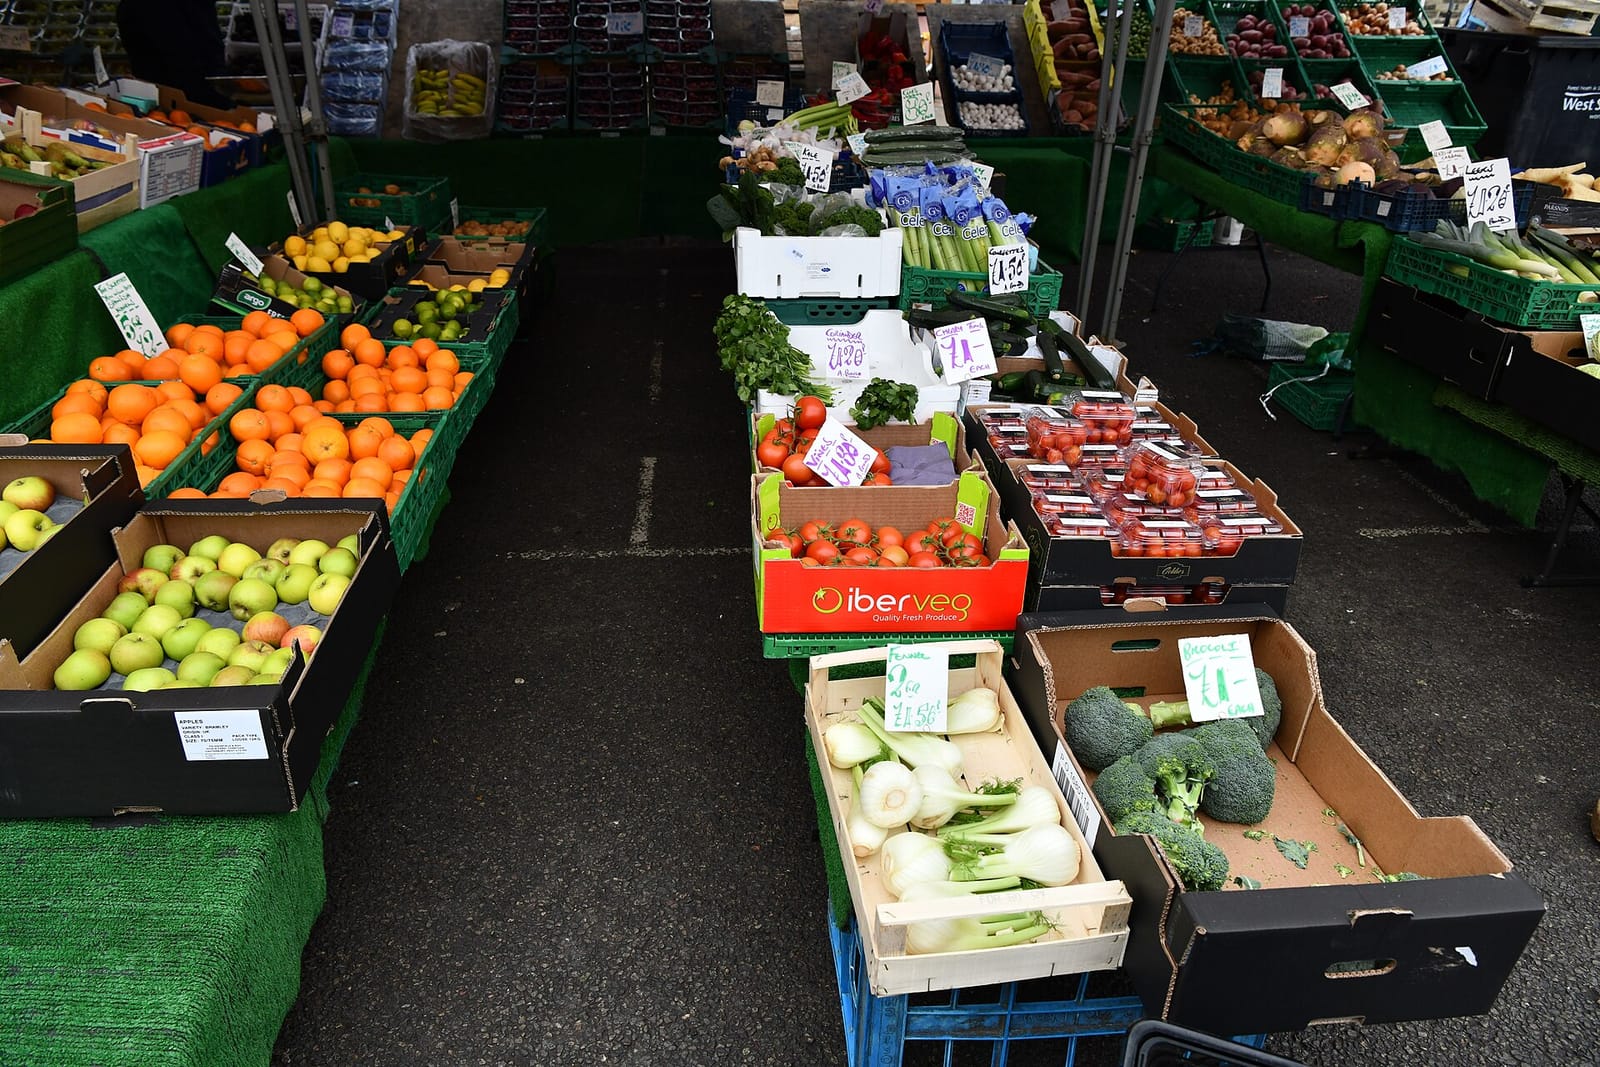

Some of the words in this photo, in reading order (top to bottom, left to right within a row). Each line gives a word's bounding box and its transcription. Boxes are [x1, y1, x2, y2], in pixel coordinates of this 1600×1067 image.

[1563, 98, 1594, 111] West
[243, 293, 265, 307] argo
[120, 314, 135, 340] 5
[847, 586, 973, 622] iberveg
[872, 614, 901, 622] Quality
[902, 613, 923, 621] Fresh
[925, 613, 957, 621] Produce
[887, 663, 907, 698] 2
